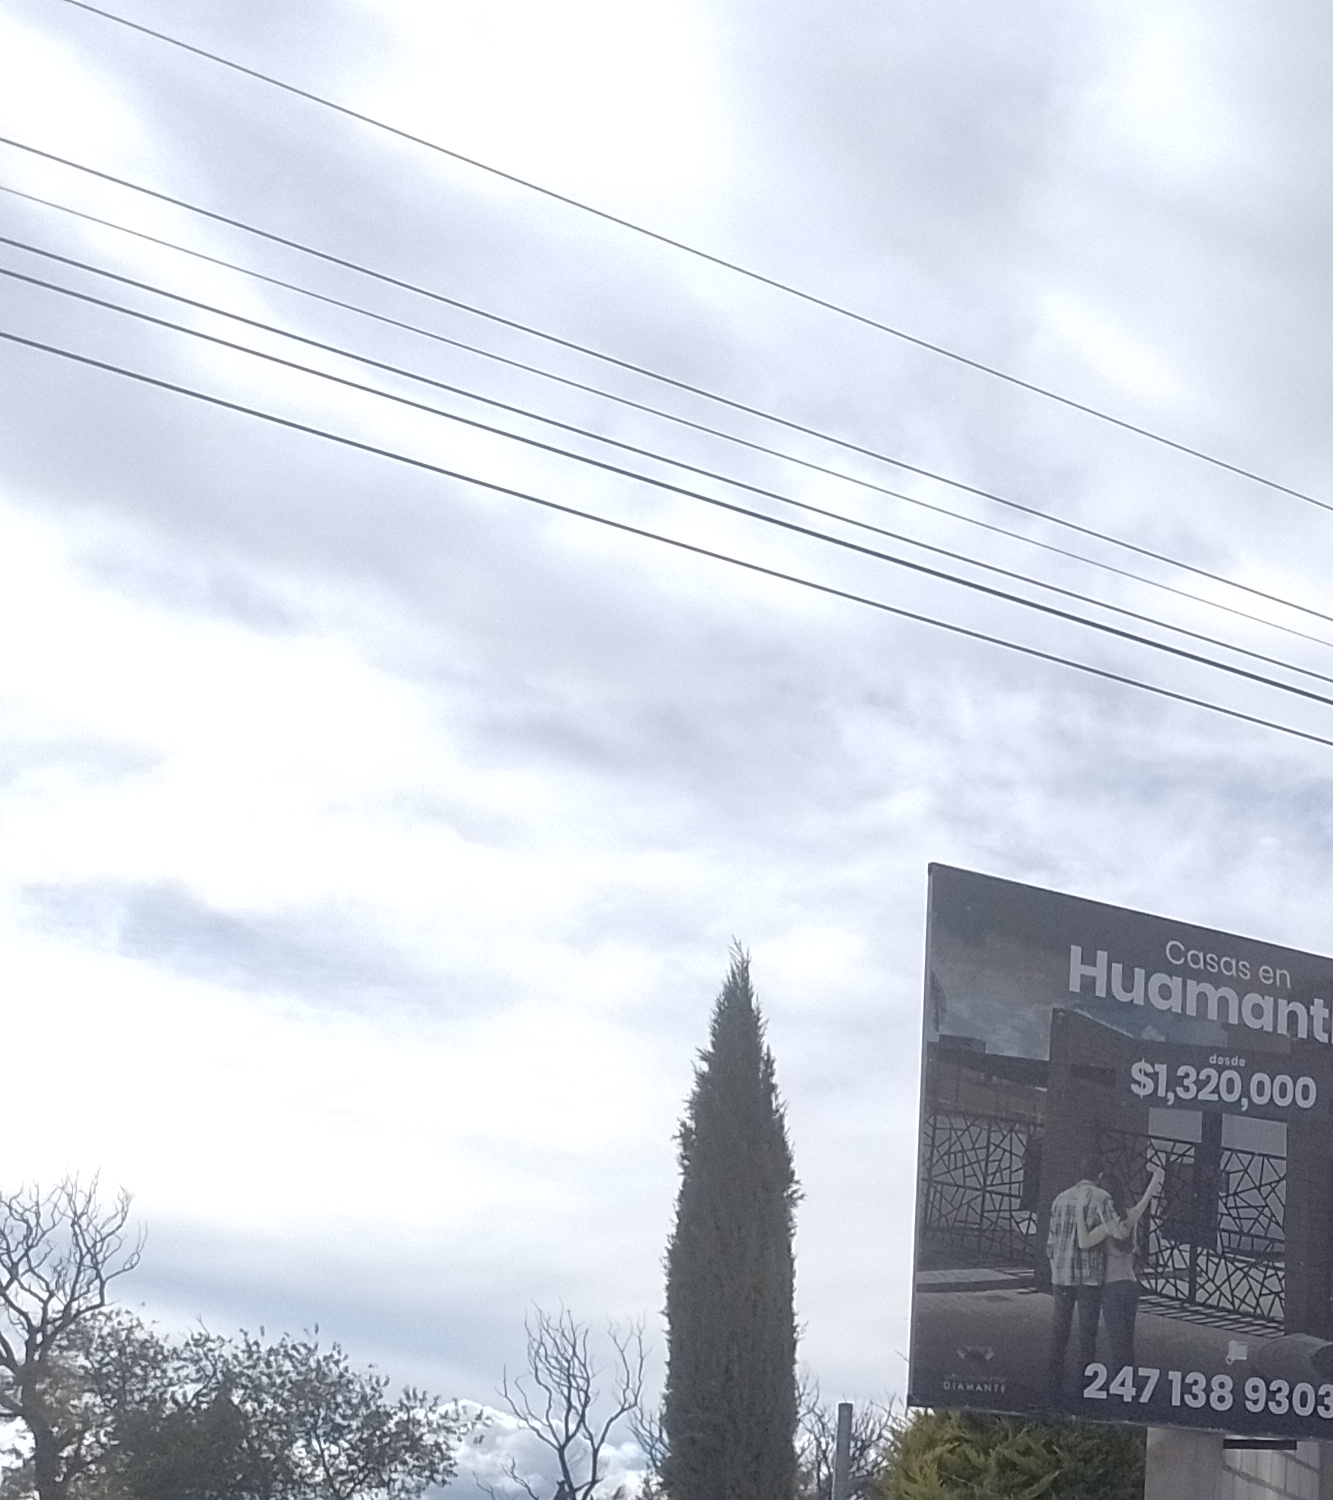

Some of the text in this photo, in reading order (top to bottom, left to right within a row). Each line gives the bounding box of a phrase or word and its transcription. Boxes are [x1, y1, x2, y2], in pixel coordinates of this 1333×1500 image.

[1165, 940, 1291, 989] Casas en
[1130, 1057, 1317, 1111] $1,320,000
[1209, 1054, 1246, 1067] desde
[1083, 1362, 1160, 1403] 247
[1168, 1370, 1234, 1411] 138
